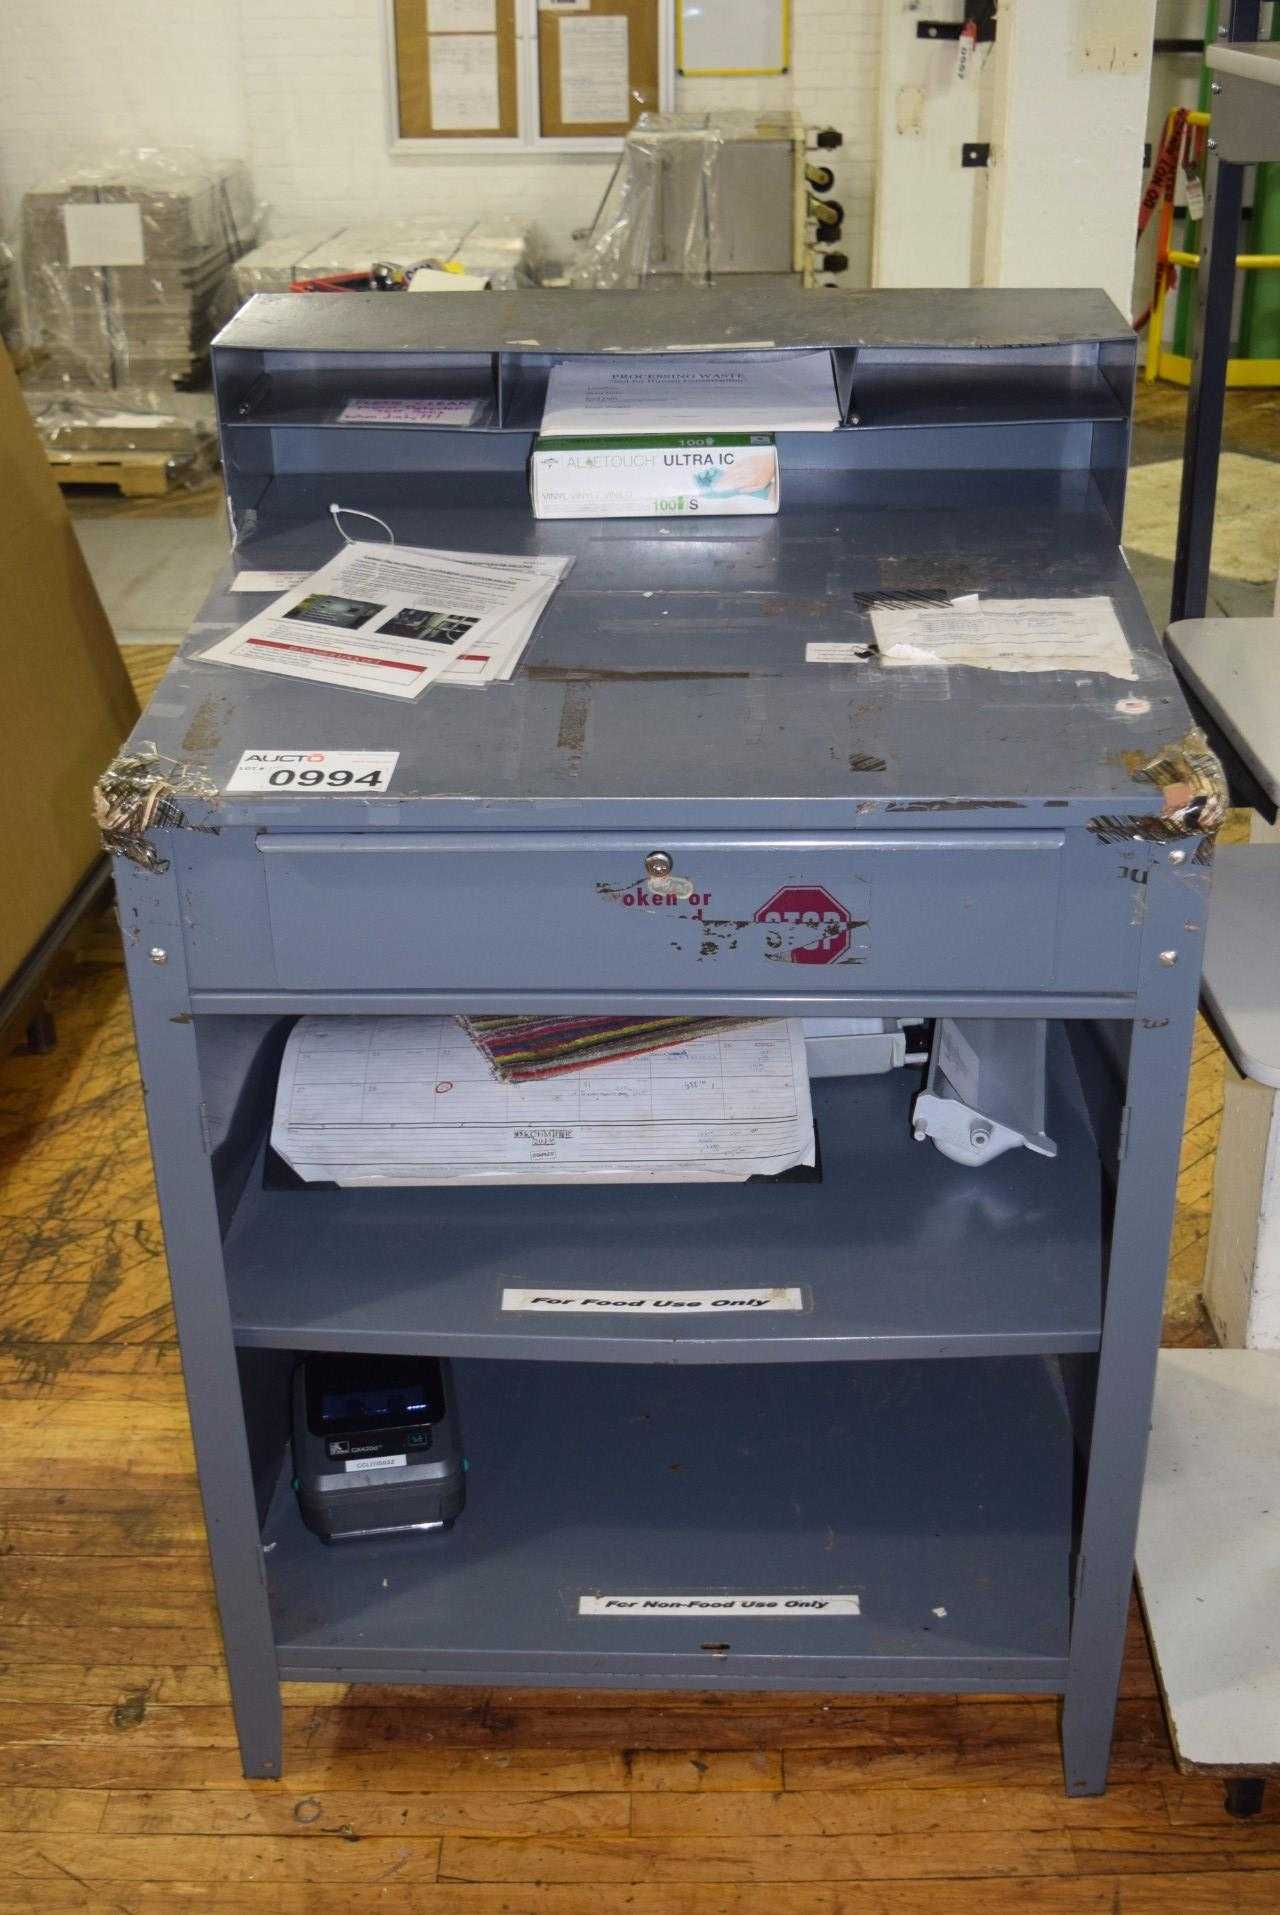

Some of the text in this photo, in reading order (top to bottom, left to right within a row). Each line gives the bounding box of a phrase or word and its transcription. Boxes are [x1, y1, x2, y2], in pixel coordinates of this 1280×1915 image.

[663, 453, 714, 467] ULTRA
[719, 453, 735, 466] IC
[269, 769, 383, 788] 0994
[688, 891, 712, 906] or
[530, 1296, 770, 1308] For Food Use Only
[605, 1599, 830, 1609] For Non-Food Use Only
